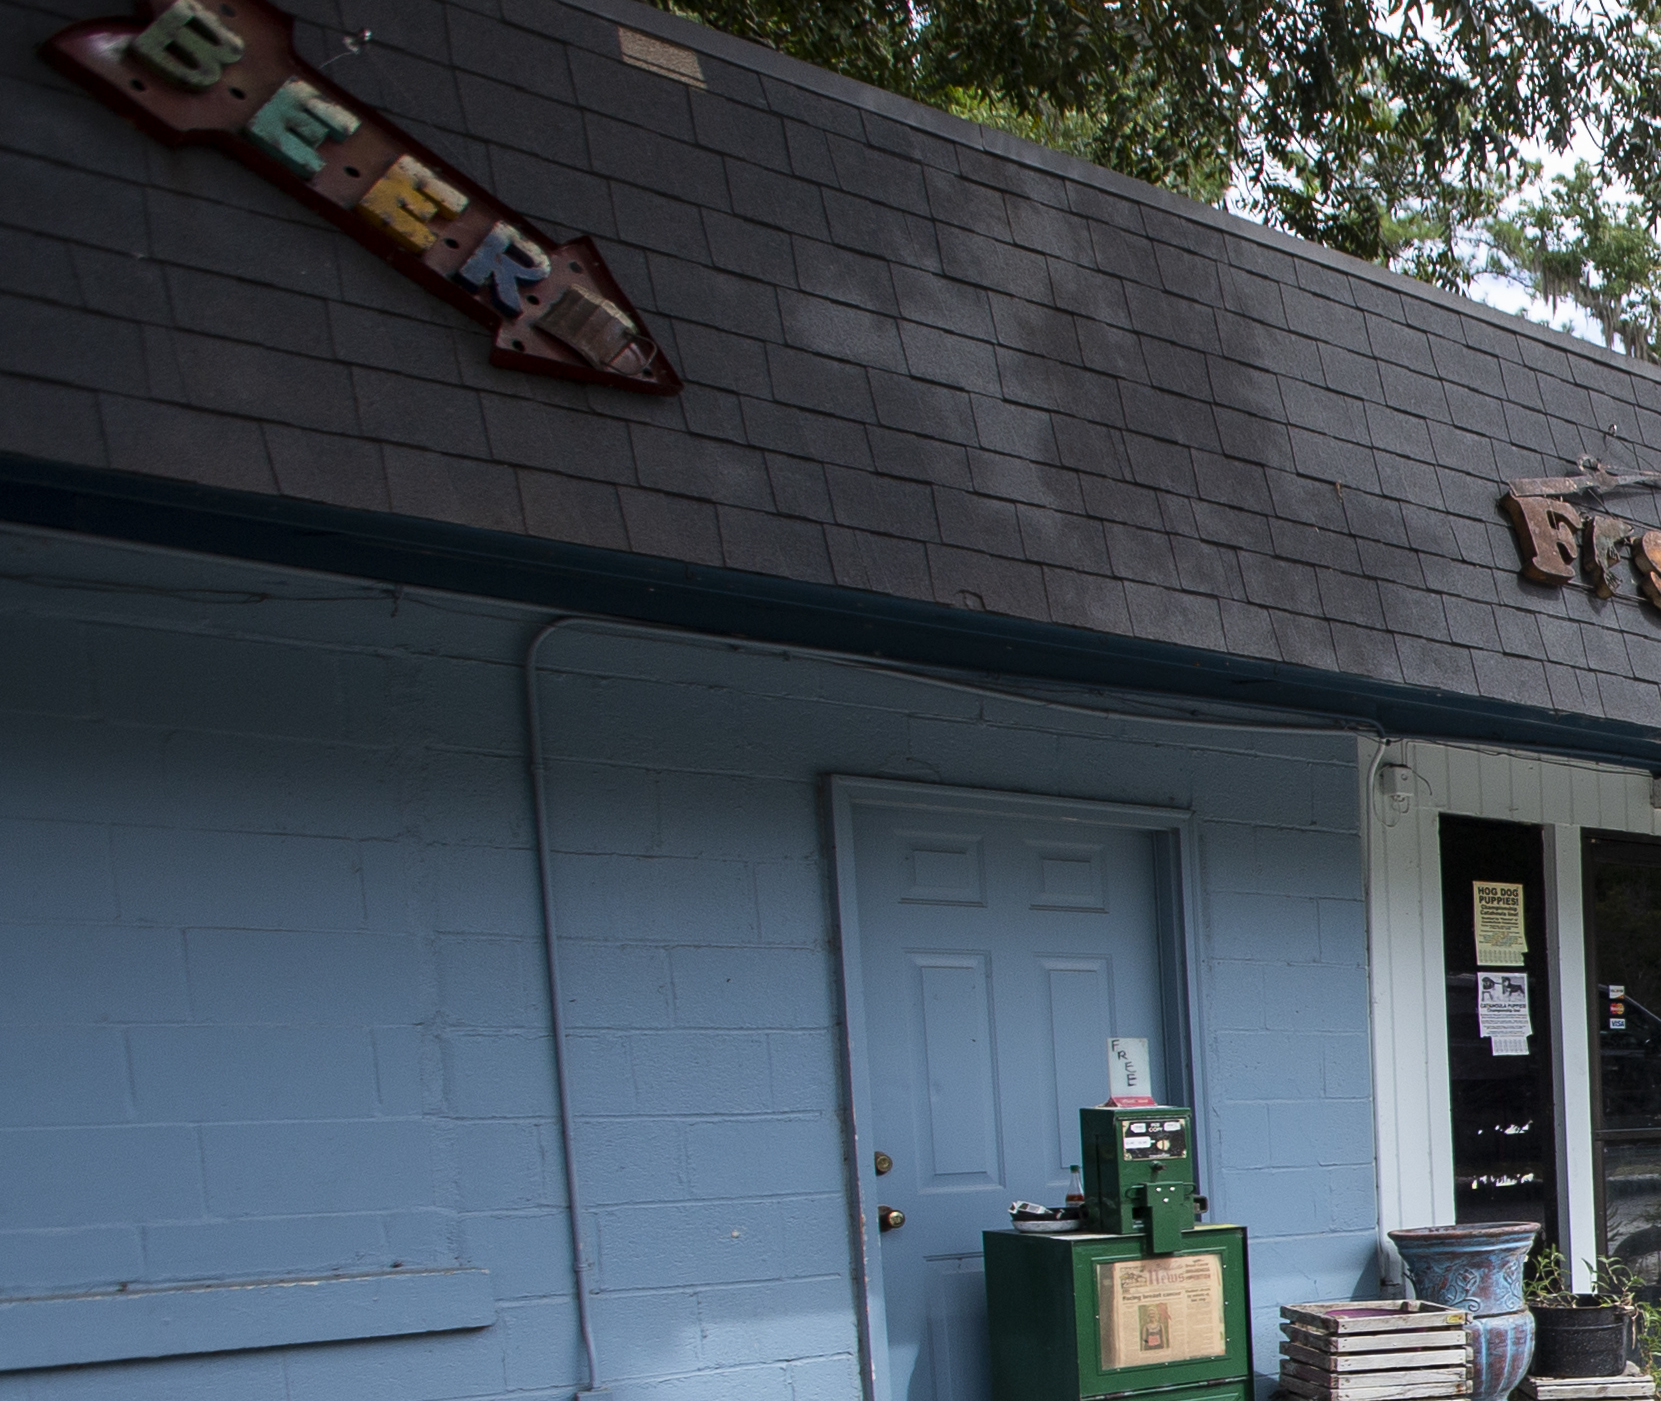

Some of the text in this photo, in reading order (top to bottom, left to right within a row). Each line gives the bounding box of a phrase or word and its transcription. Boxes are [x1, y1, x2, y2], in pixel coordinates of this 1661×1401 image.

[130, 0, 552, 318] BEER
[1478, 887, 1519, 897] HOG DOG
[1111, 1039, 1137, 1087] FREE
